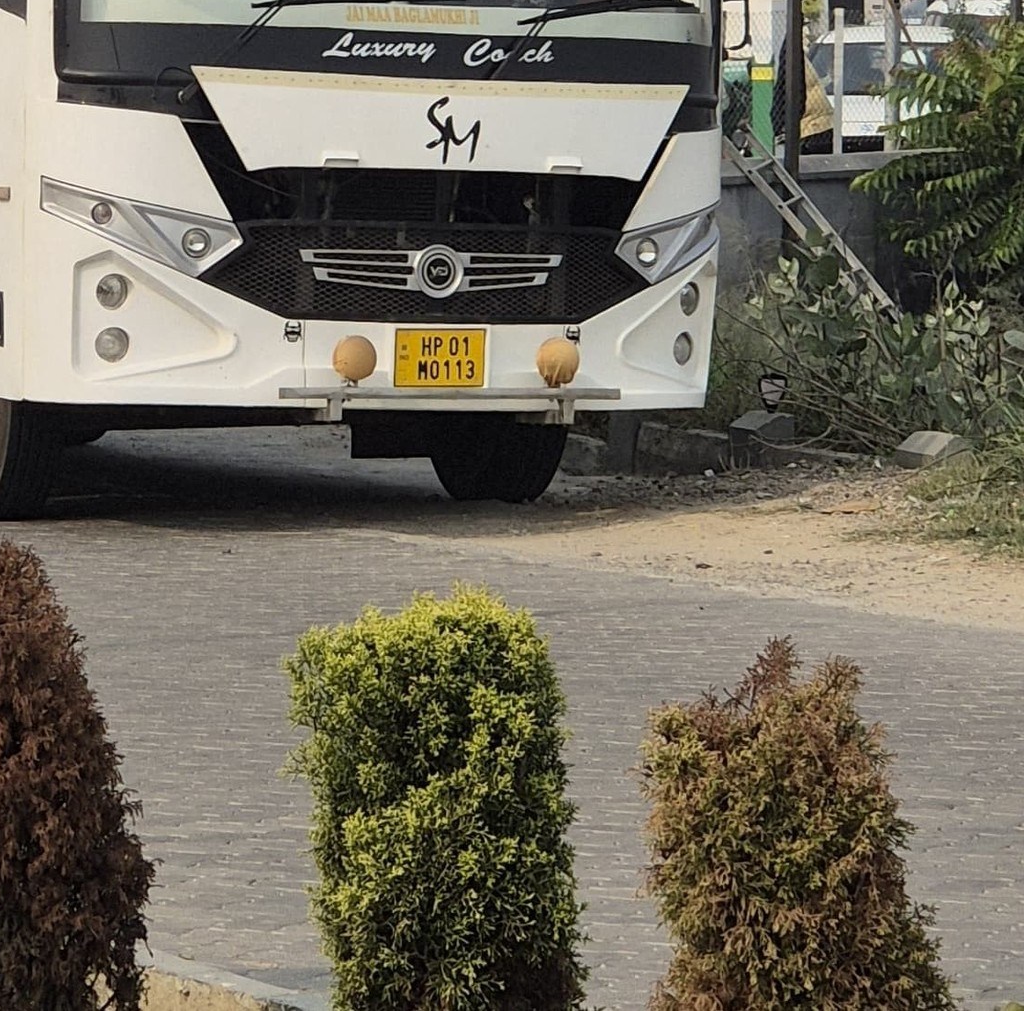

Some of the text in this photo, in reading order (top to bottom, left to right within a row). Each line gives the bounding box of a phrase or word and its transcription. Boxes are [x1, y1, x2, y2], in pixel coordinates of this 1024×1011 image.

[322, 32, 555, 67] Luxury Coch
[421, 336, 469, 356] HP 01
